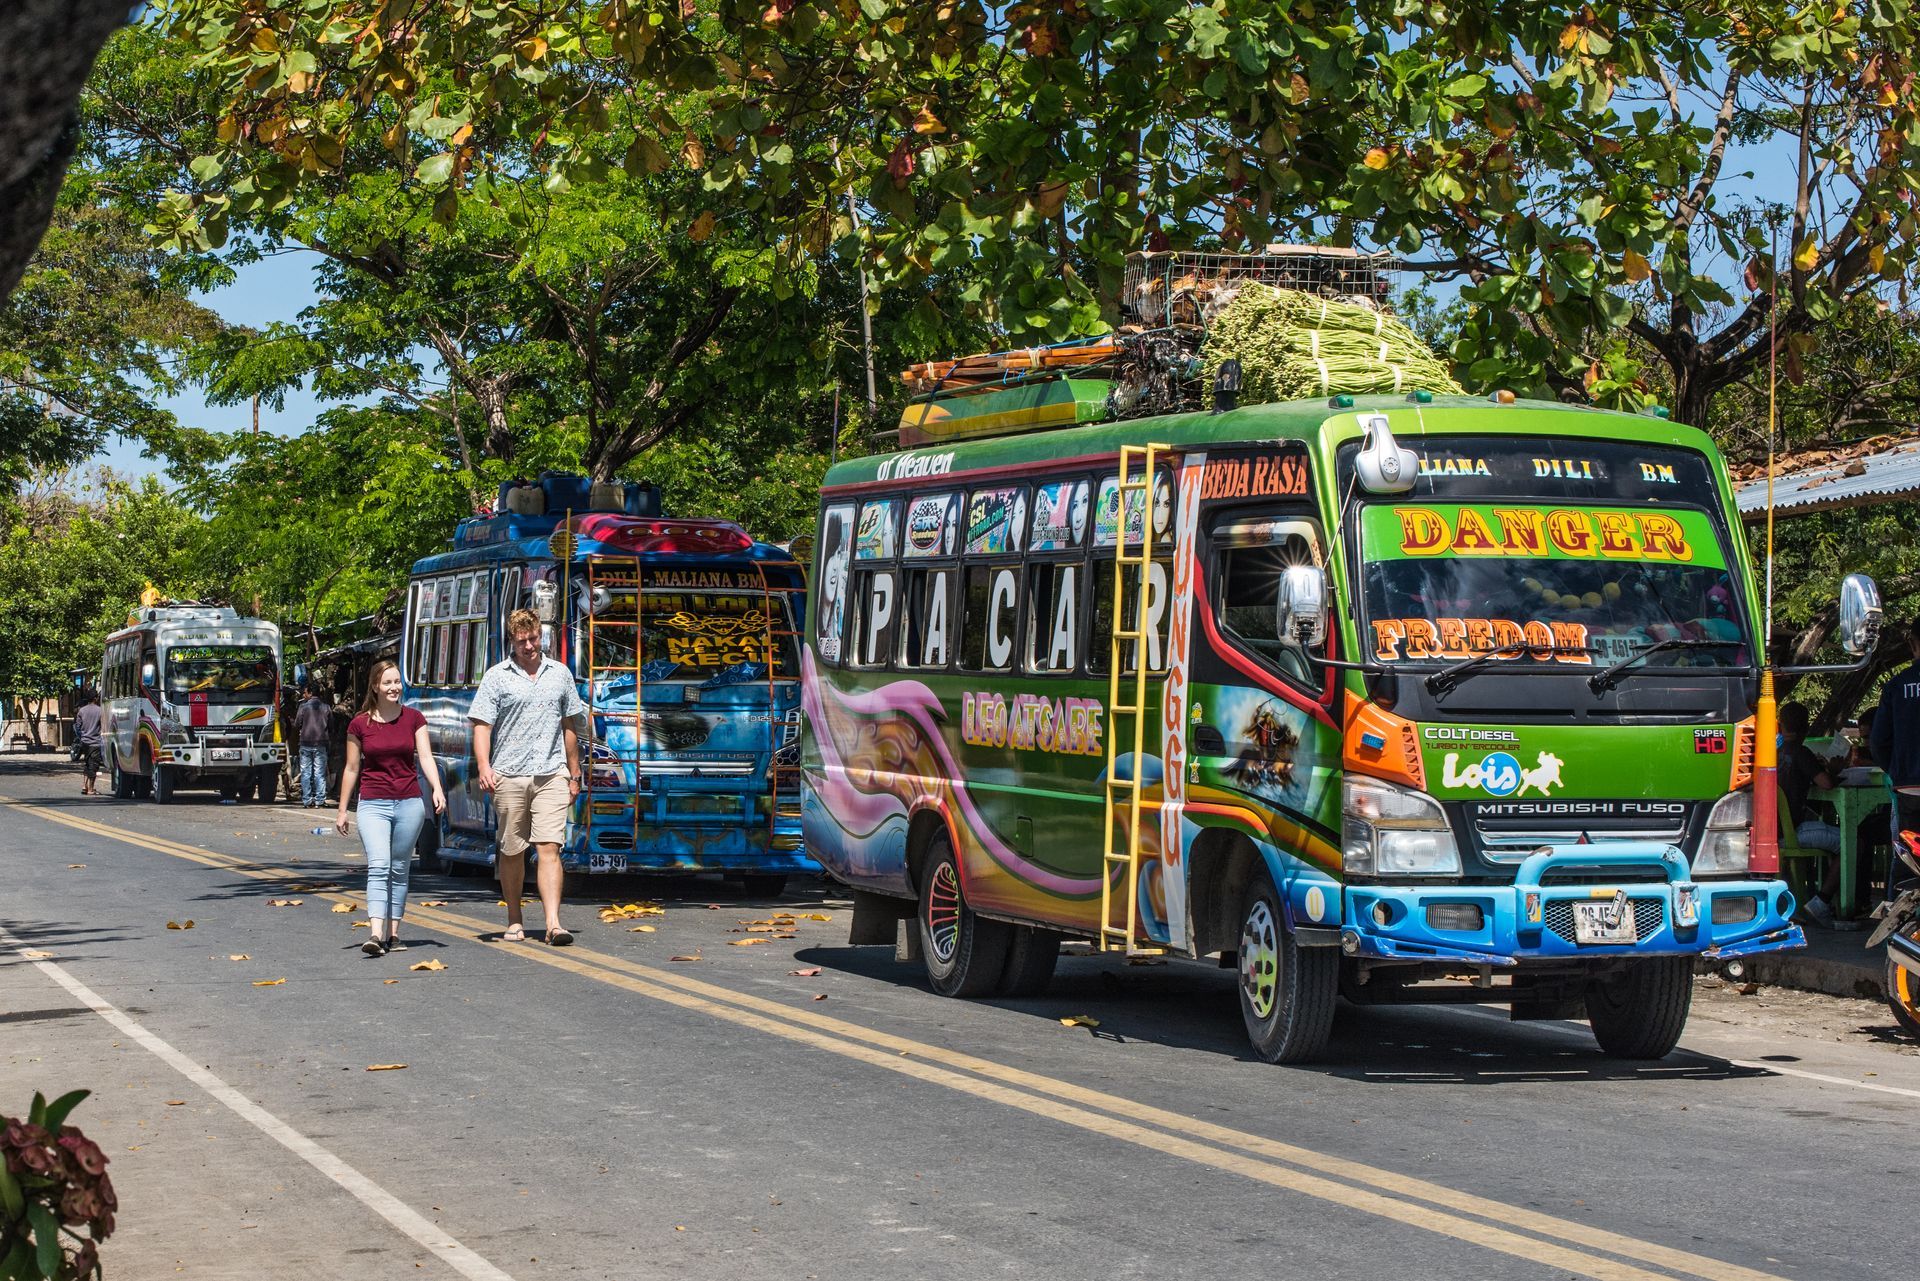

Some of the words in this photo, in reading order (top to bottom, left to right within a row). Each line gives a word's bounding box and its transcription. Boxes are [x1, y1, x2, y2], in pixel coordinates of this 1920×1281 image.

[877, 453, 903, 481] of
[894, 452, 955, 480] Heaven
[1532, 458, 1594, 479] DILI
[1200, 457, 1250, 500] BEDA
[1251, 455, 1308, 496] RASA
[1393, 508, 1694, 561] DANGER
[654, 571, 734, 588] MALIANA
[667, 636, 779, 648] NAKAL
[1372, 617, 1592, 664] FREEDOM
[670, 653, 782, 666] KECIL
[1162, 464, 1201, 867] TUNGGU
[962, 692, 1007, 749] LEO
[1007, 694, 1103, 756] ATSABE
[1424, 727, 1470, 740] COLT
[1470, 730, 1520, 741] DIESEL
[1694, 729, 1726, 737] SUPER
[1695, 737, 1727, 753] HD
[1442, 752, 1517, 790] Lois
[1477, 803, 1614, 814] MITSUBISHI
[1622, 803, 1685, 814] FUSO
